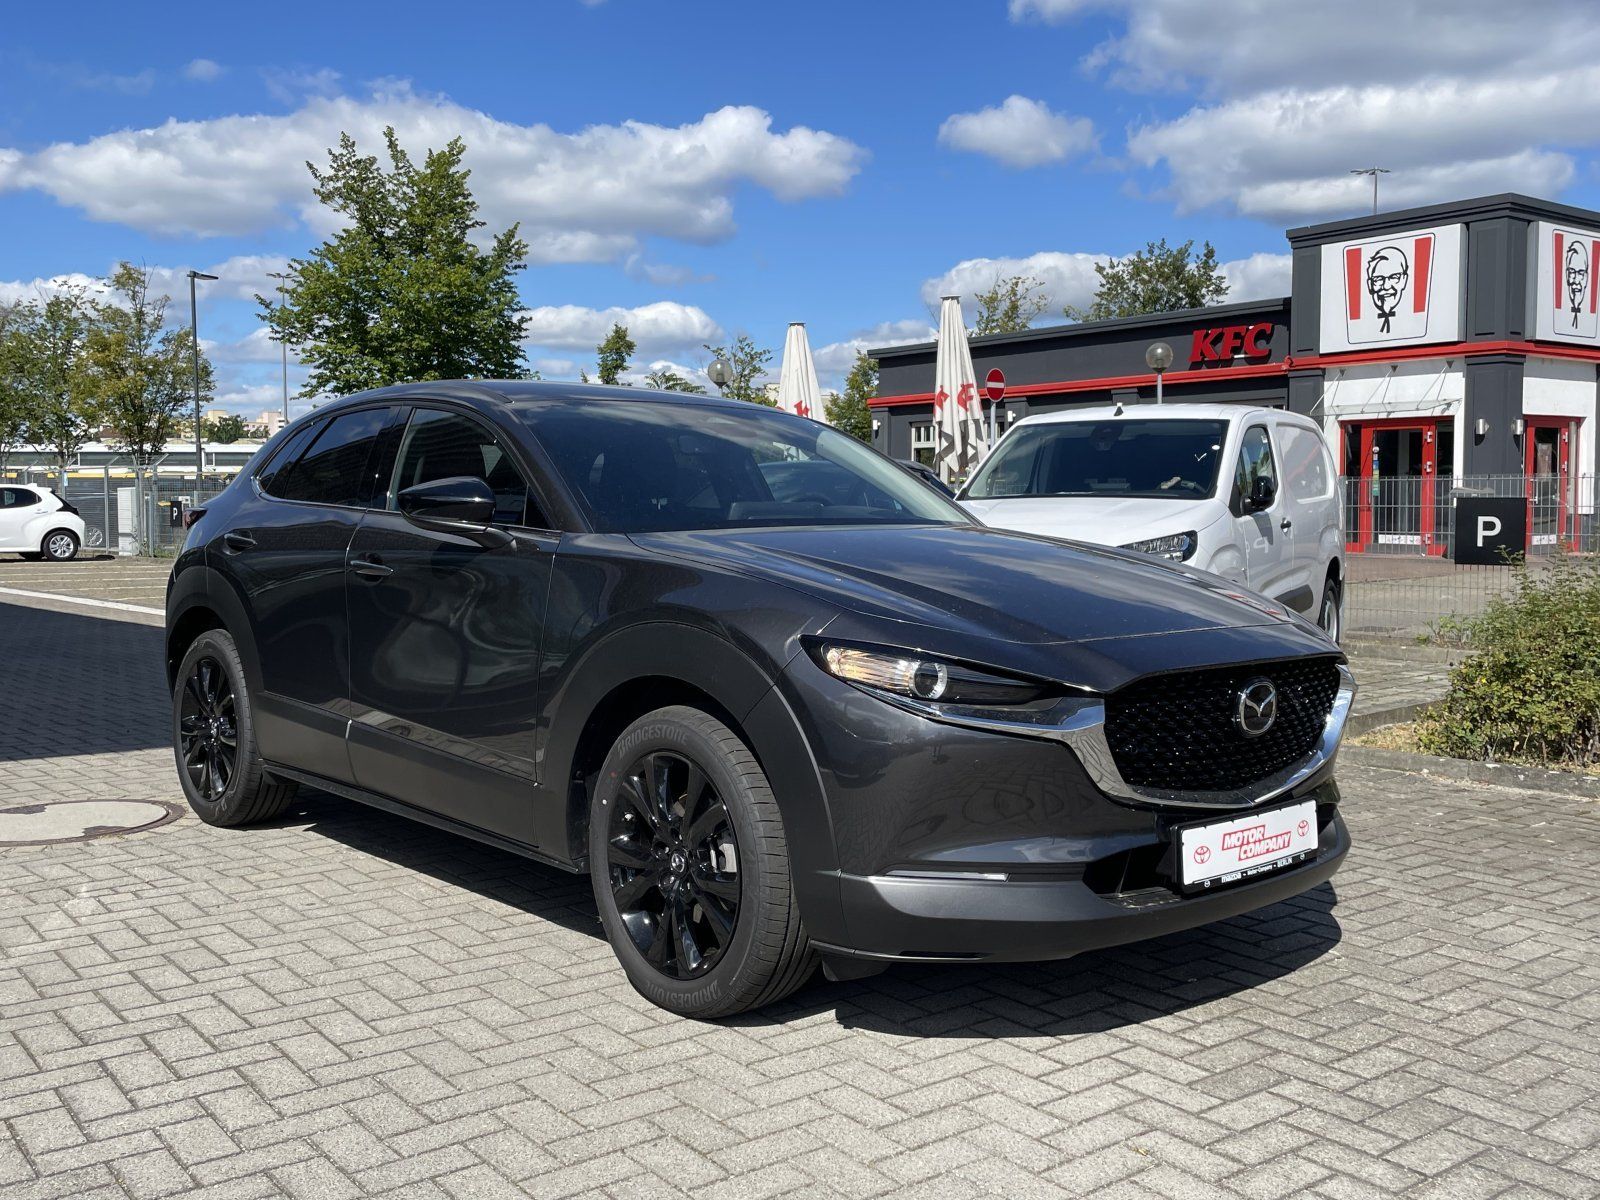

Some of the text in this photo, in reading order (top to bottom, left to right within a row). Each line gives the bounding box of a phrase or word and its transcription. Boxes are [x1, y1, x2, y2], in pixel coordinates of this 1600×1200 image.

[1187, 323, 1273, 362] KFC
[172, 507, 178, 520] P
[1476, 515, 1502, 547] P
[617, 724, 689, 760] BRIDGESTONE
[1223, 826, 1266, 850] MOTOR
[1239, 833, 1292, 860] COMPANY
